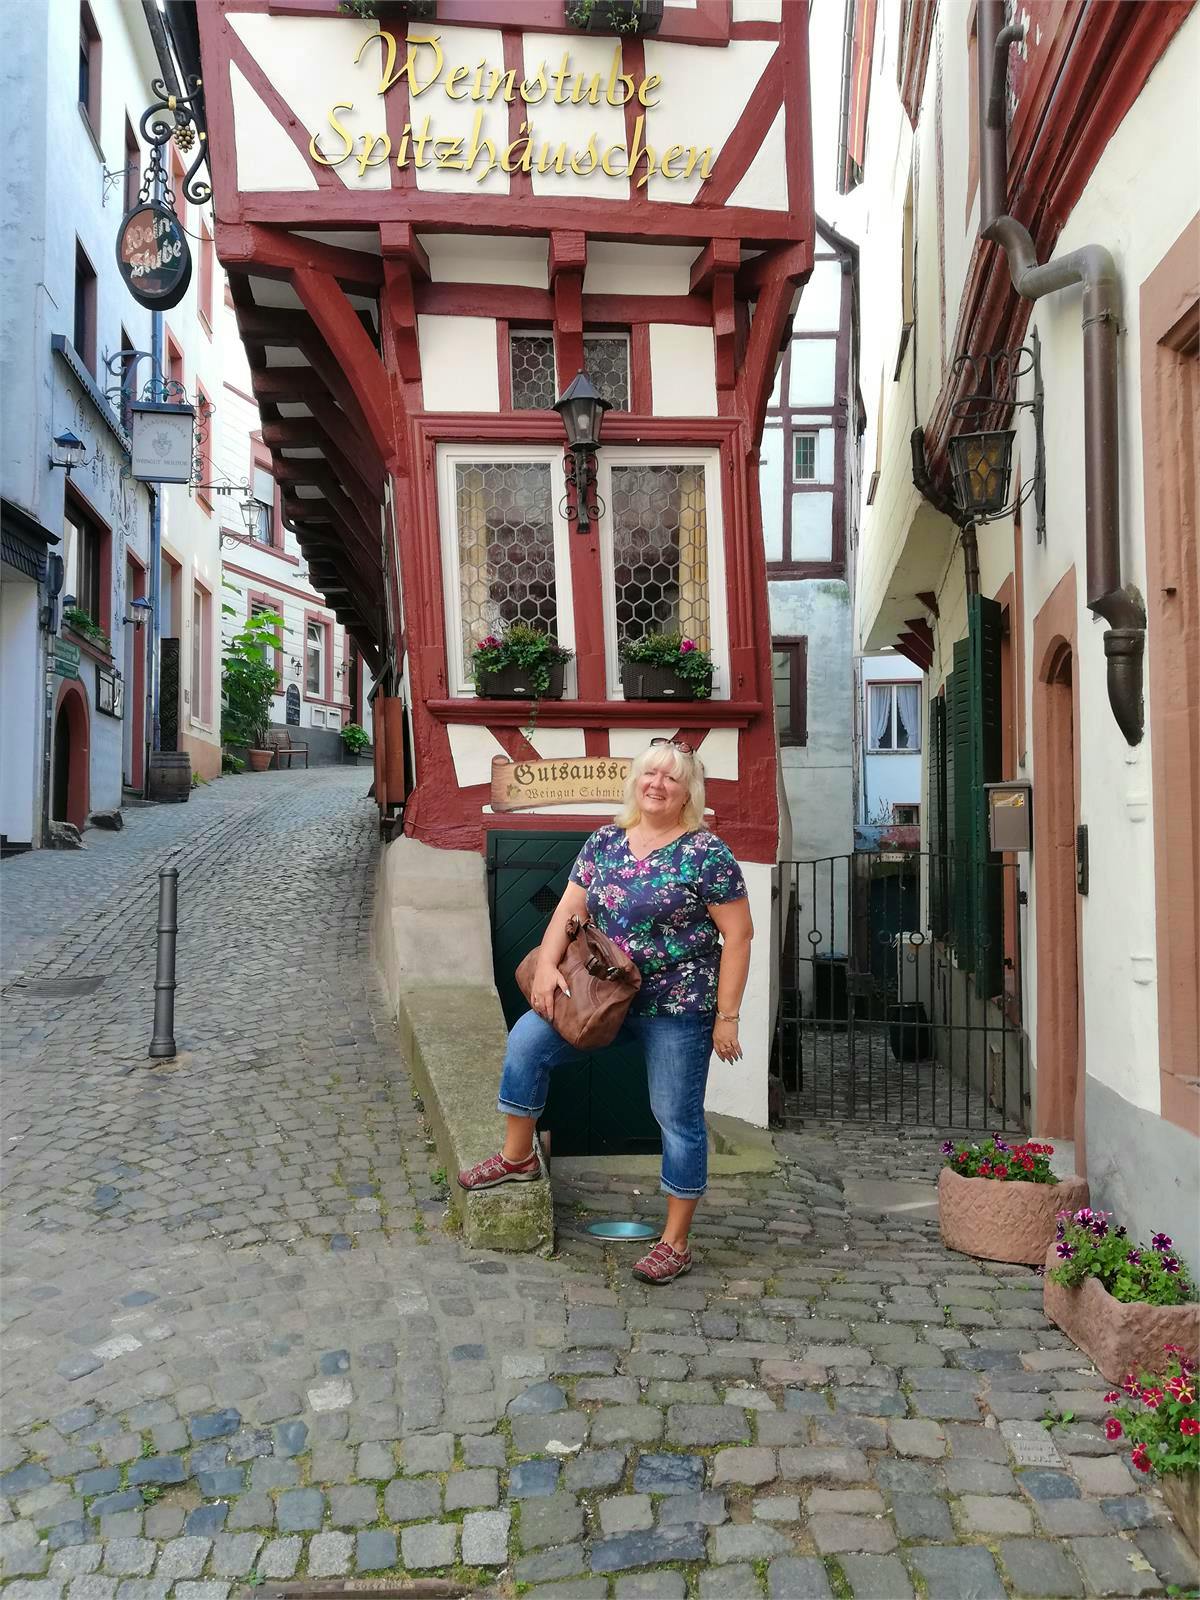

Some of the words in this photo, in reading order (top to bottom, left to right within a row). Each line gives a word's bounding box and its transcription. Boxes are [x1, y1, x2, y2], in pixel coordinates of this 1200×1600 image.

[354, 31, 663, 107] Weinstube
[309, 101, 713, 189] Spitzhäuschen
[513, 761, 627, 786] Gutsaussc
[525, 787, 575, 800] Weingut
